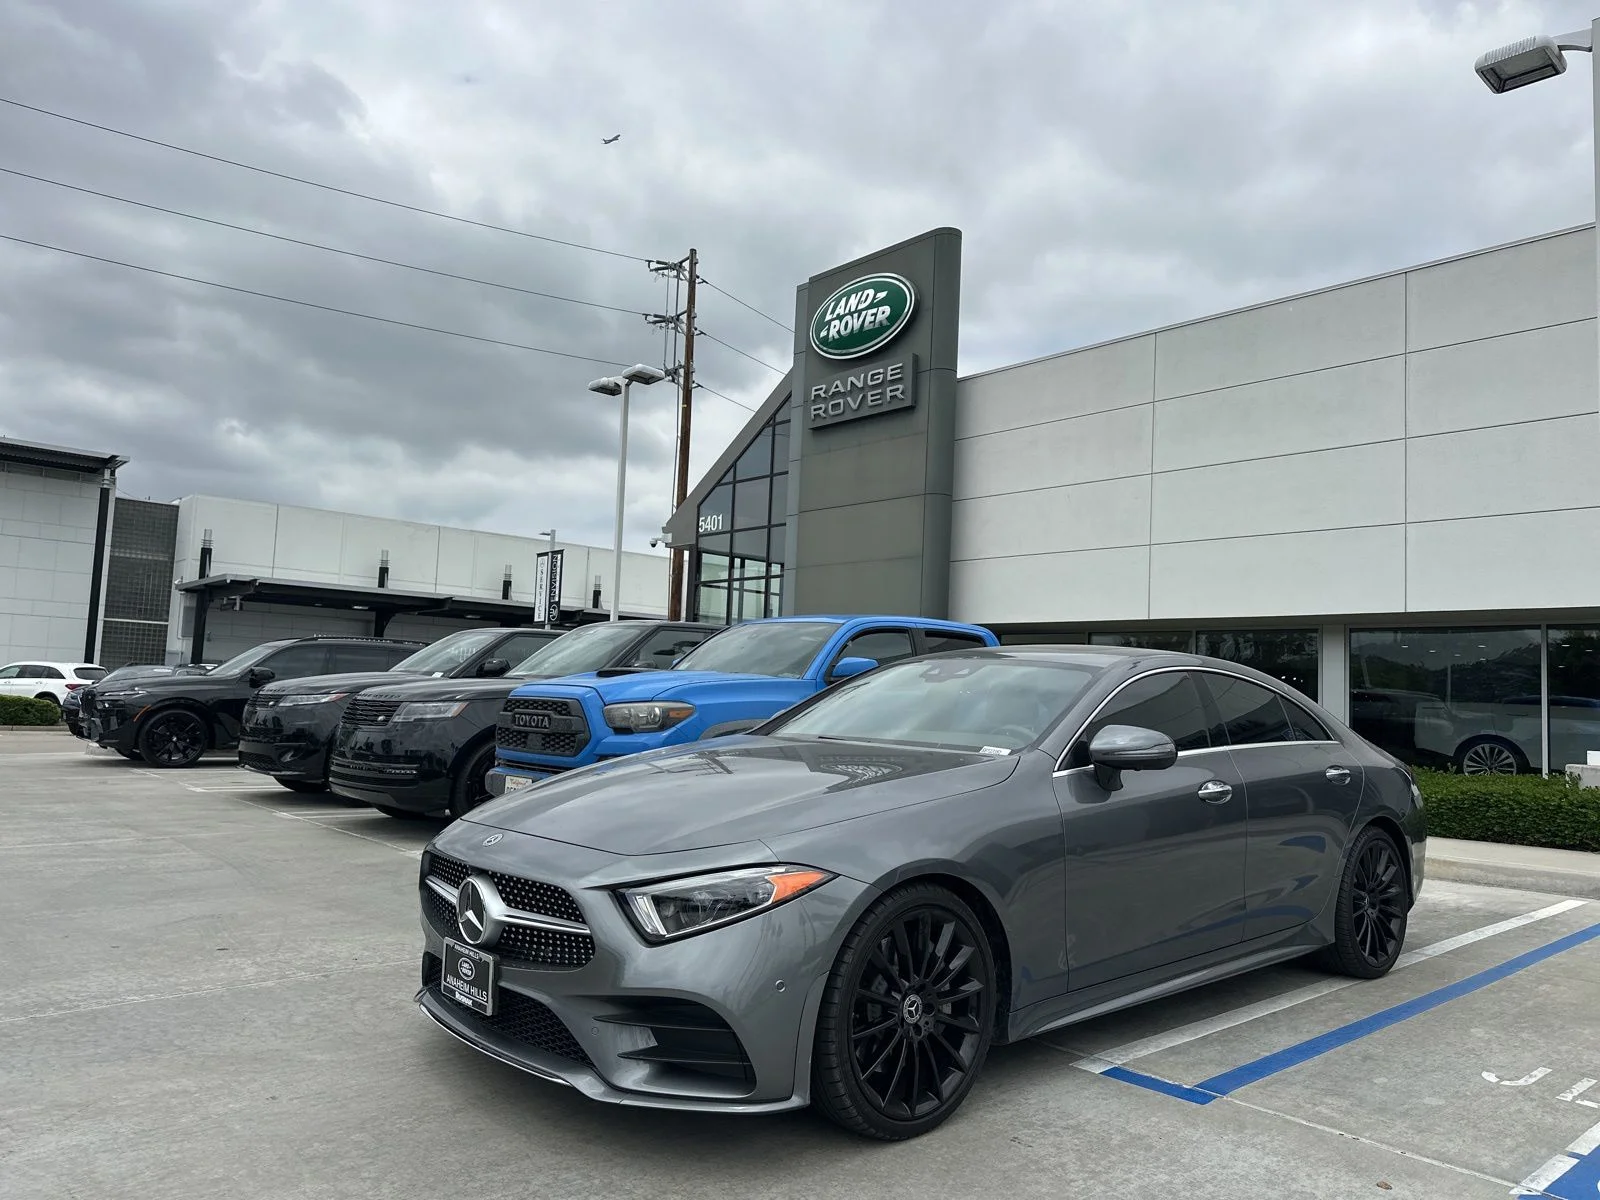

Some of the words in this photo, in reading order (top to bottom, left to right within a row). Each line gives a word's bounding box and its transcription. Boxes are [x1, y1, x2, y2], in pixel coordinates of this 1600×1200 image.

[824, 288, 875, 322] LAND
[828, 305, 891, 342] ROVER
[811, 363, 904, 400] RANGE
[810, 384, 905, 421] ROVER
[698, 513, 723, 533] 5401
[515, 714, 549, 728] TOYOTA
[446, 974, 470, 994] ANAHEIM
[470, 985, 487, 1002] HILLS
